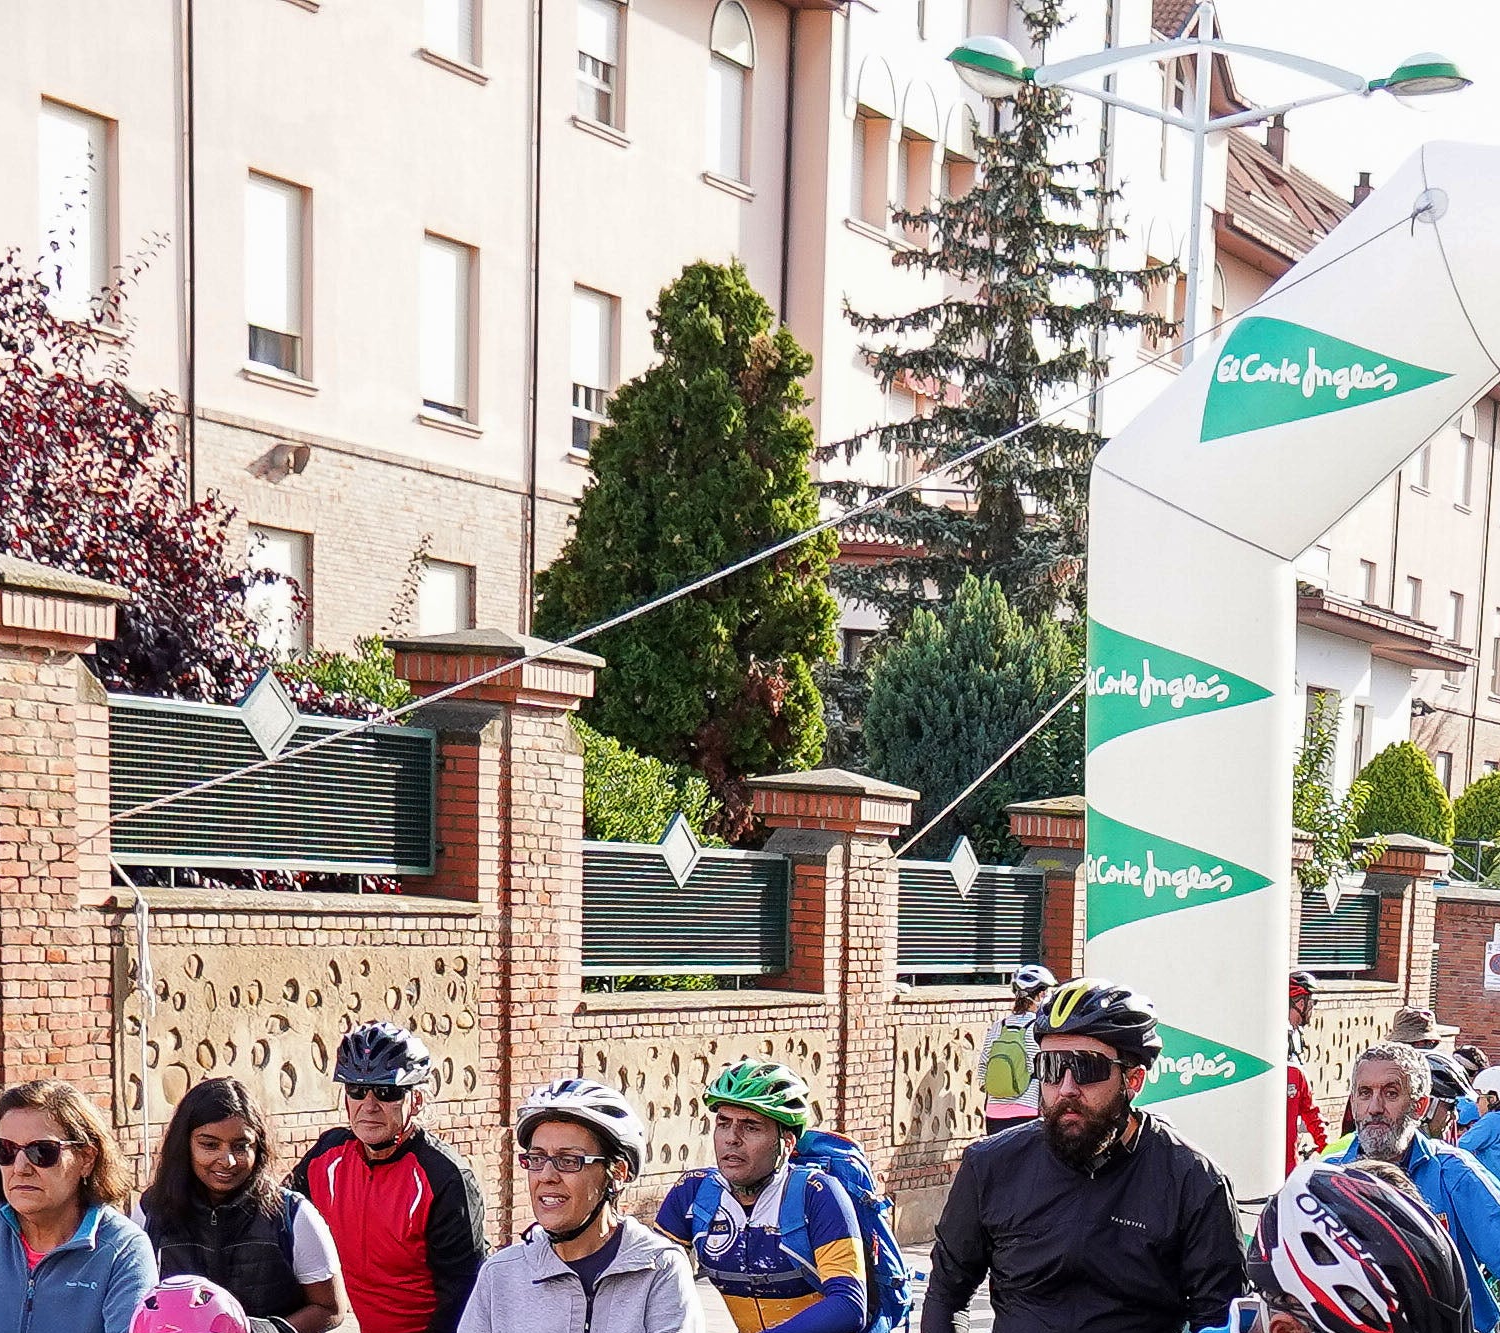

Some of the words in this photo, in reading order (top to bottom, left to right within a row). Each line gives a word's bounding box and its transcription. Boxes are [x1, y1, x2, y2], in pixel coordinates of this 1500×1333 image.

[1217, 355, 1240, 383] El
[1240, 354, 1300, 385] Corte
[1302, 347, 1398, 399] Inglés
[1139, 659, 1230, 708] Inglés
[1143, 850, 1233, 898] Inglés
